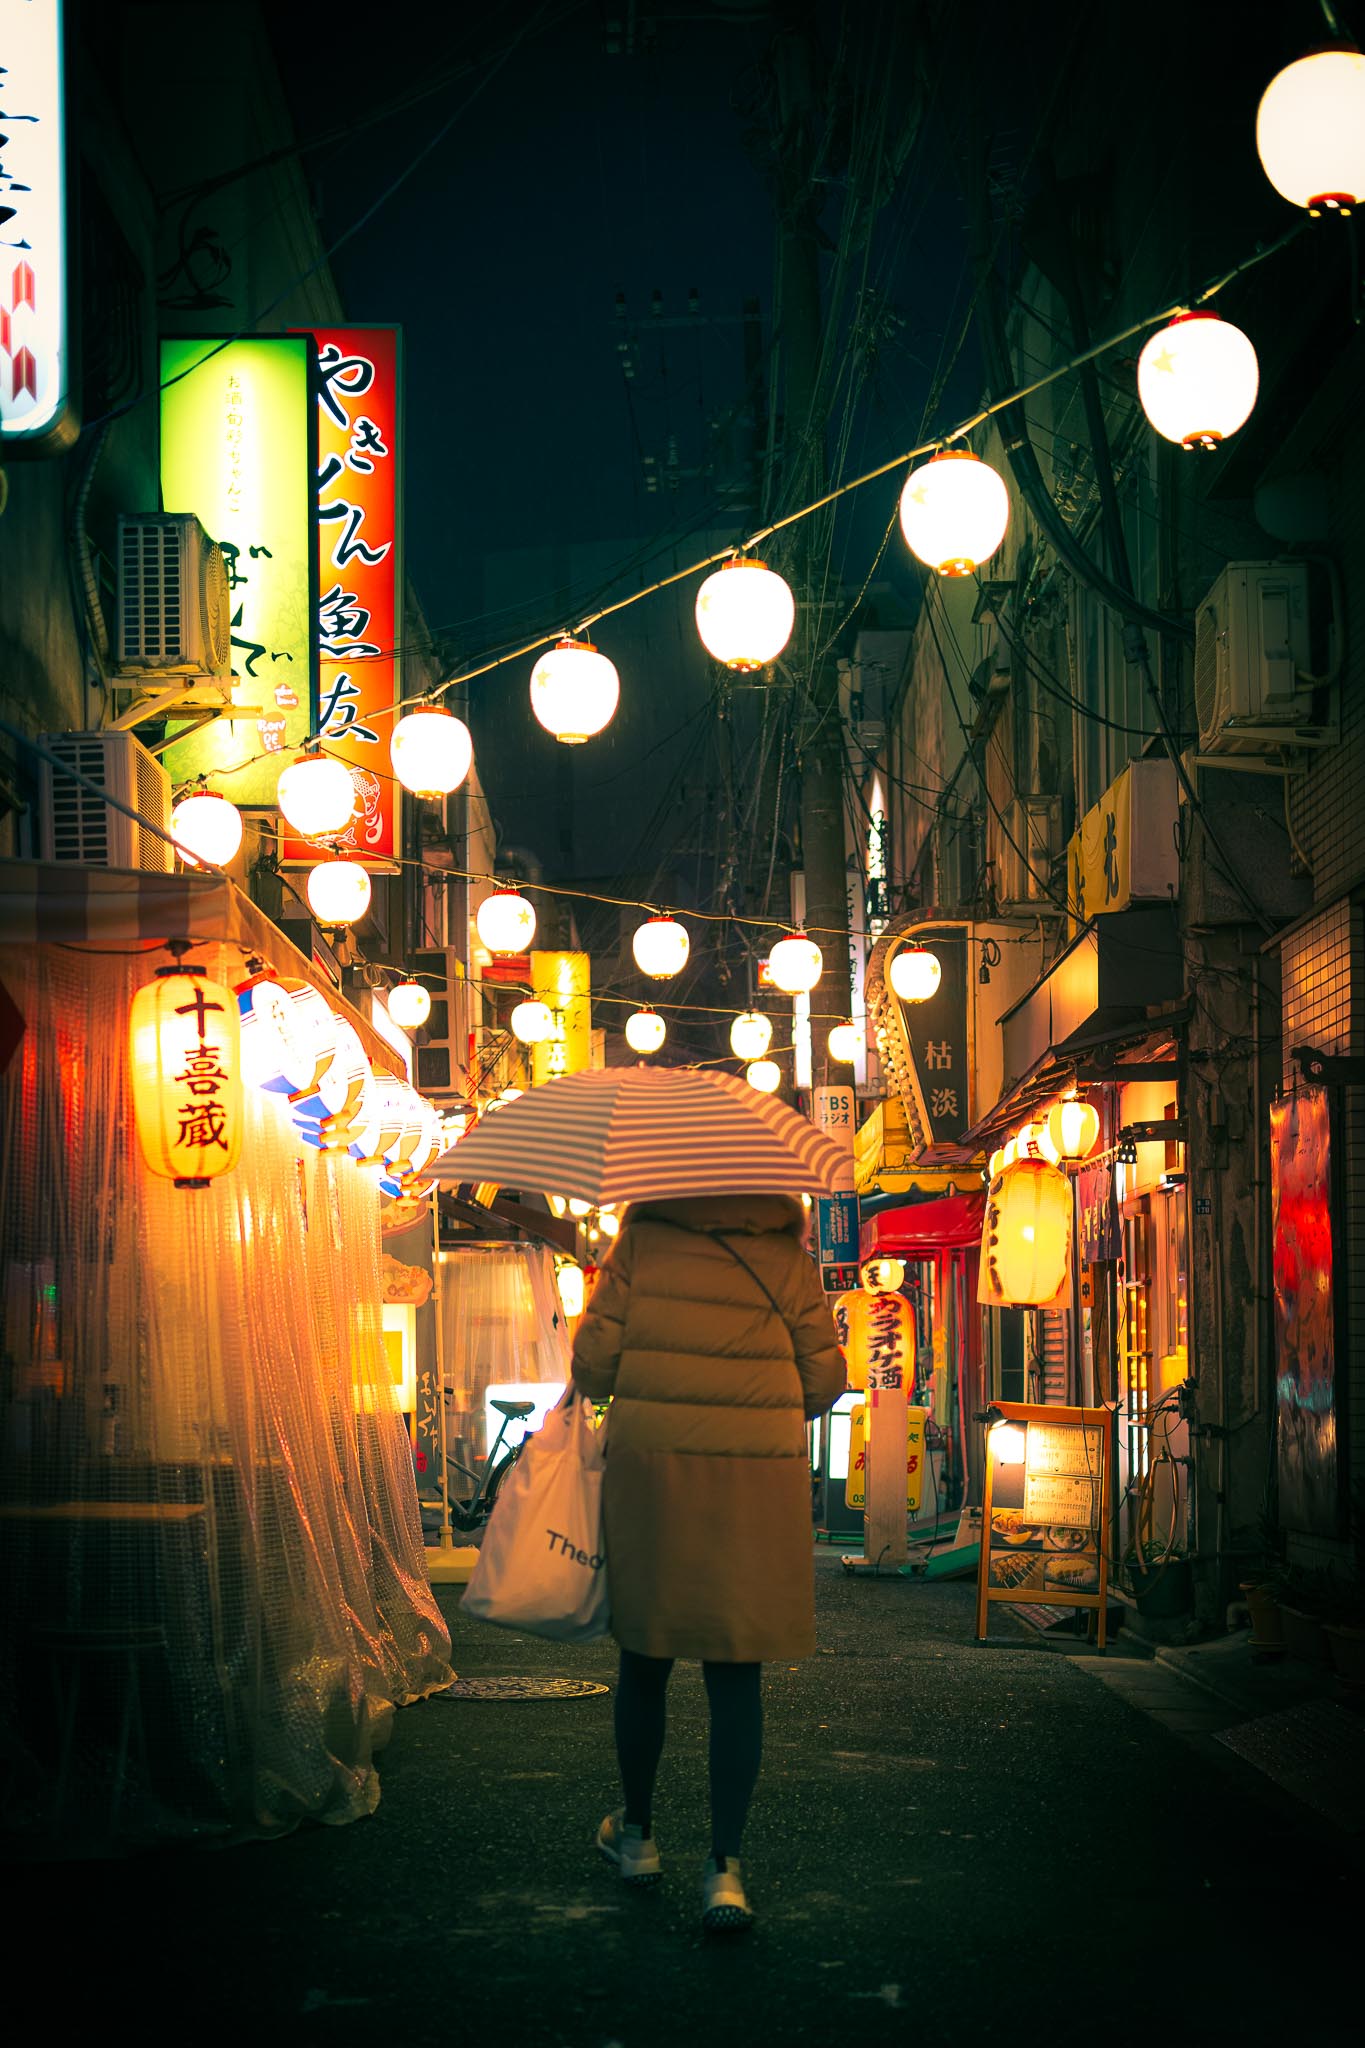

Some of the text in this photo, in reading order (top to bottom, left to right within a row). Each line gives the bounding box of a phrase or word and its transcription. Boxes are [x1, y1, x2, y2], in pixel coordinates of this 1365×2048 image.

[174, 988, 228, 1150] 十喜蔵
[924, 1041, 959, 1118] 枯淡
[819, 1097, 849, 1111] TBS
[819, 1113, 850, 1125] ラジオ
[832, 1280, 853, 1289] 1-17
